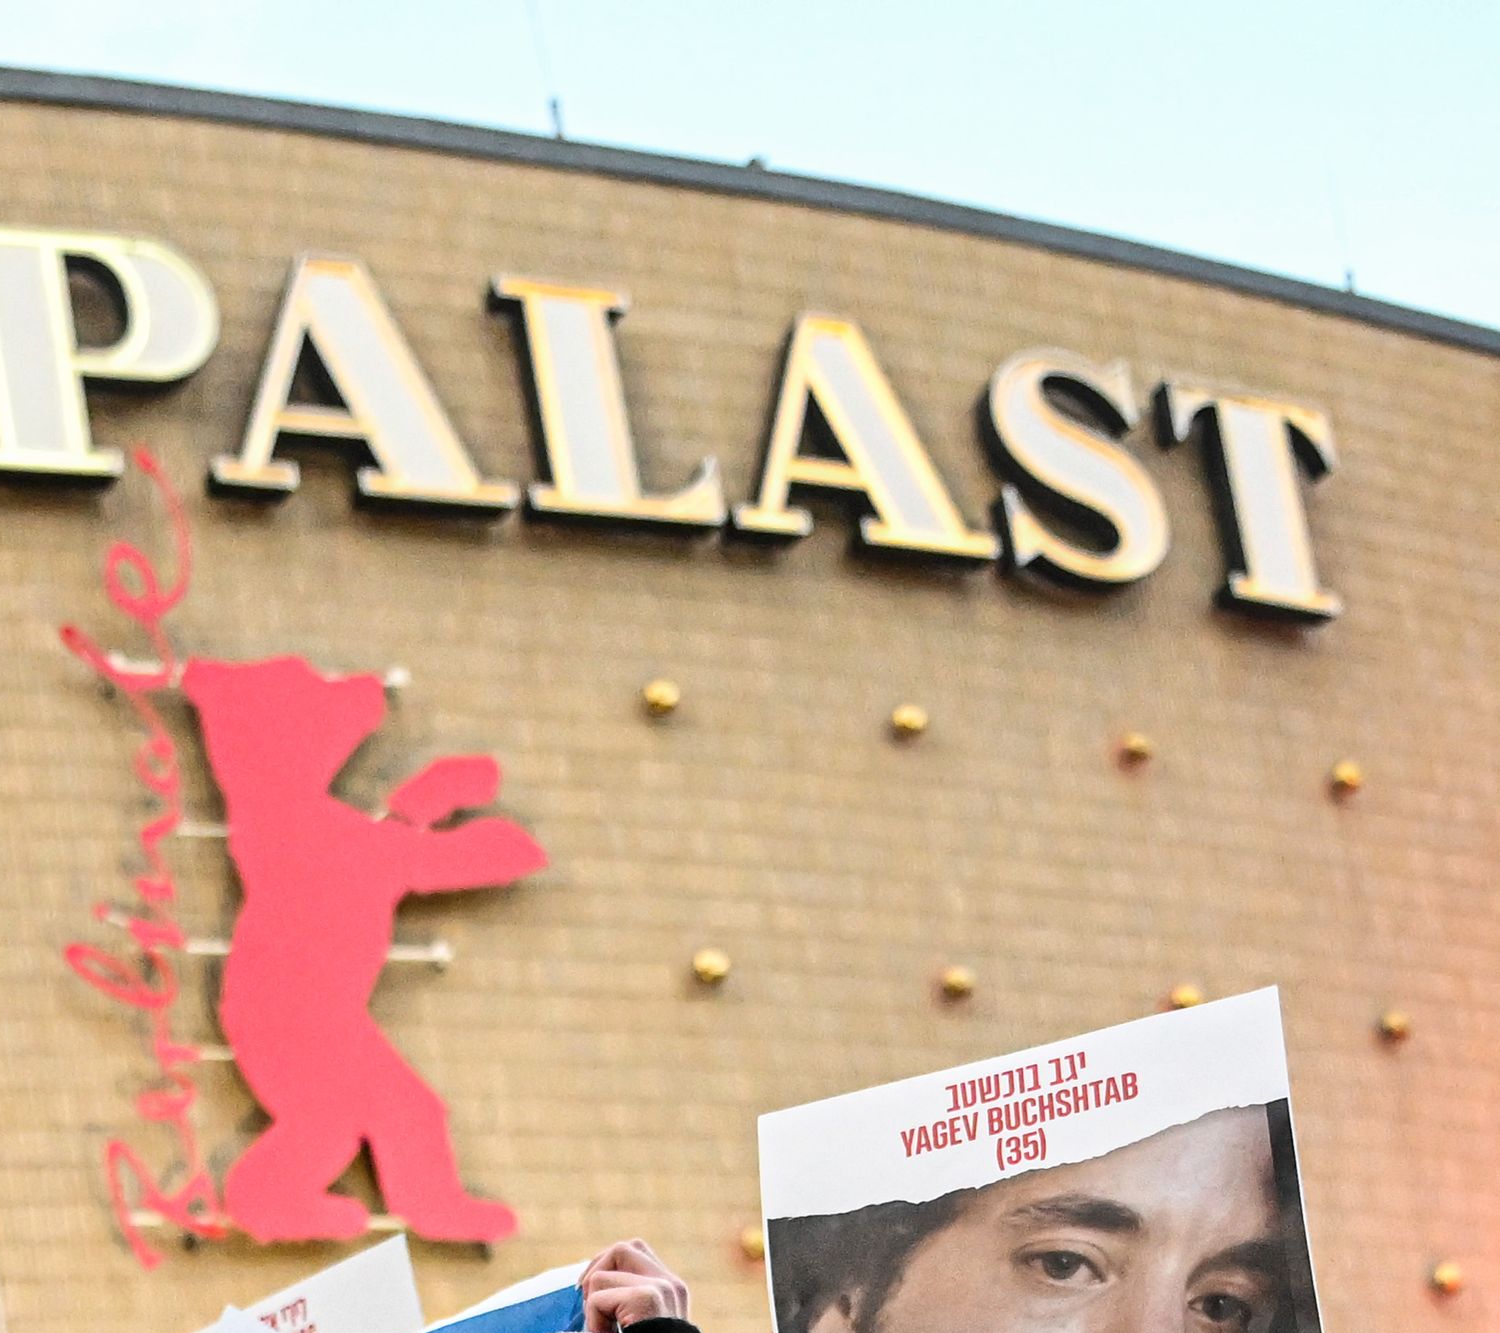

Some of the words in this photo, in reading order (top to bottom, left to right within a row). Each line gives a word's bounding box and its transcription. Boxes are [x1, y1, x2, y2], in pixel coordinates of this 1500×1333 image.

[945, 1063, 1041, 1113] בוכשטב
[1048, 1051, 1086, 1086] יגב
[900, 1111, 978, 1158] YAGEV
[987, 1071, 1138, 1135] BUCHSHTAB
[996, 1127, 1046, 1170] (35)
